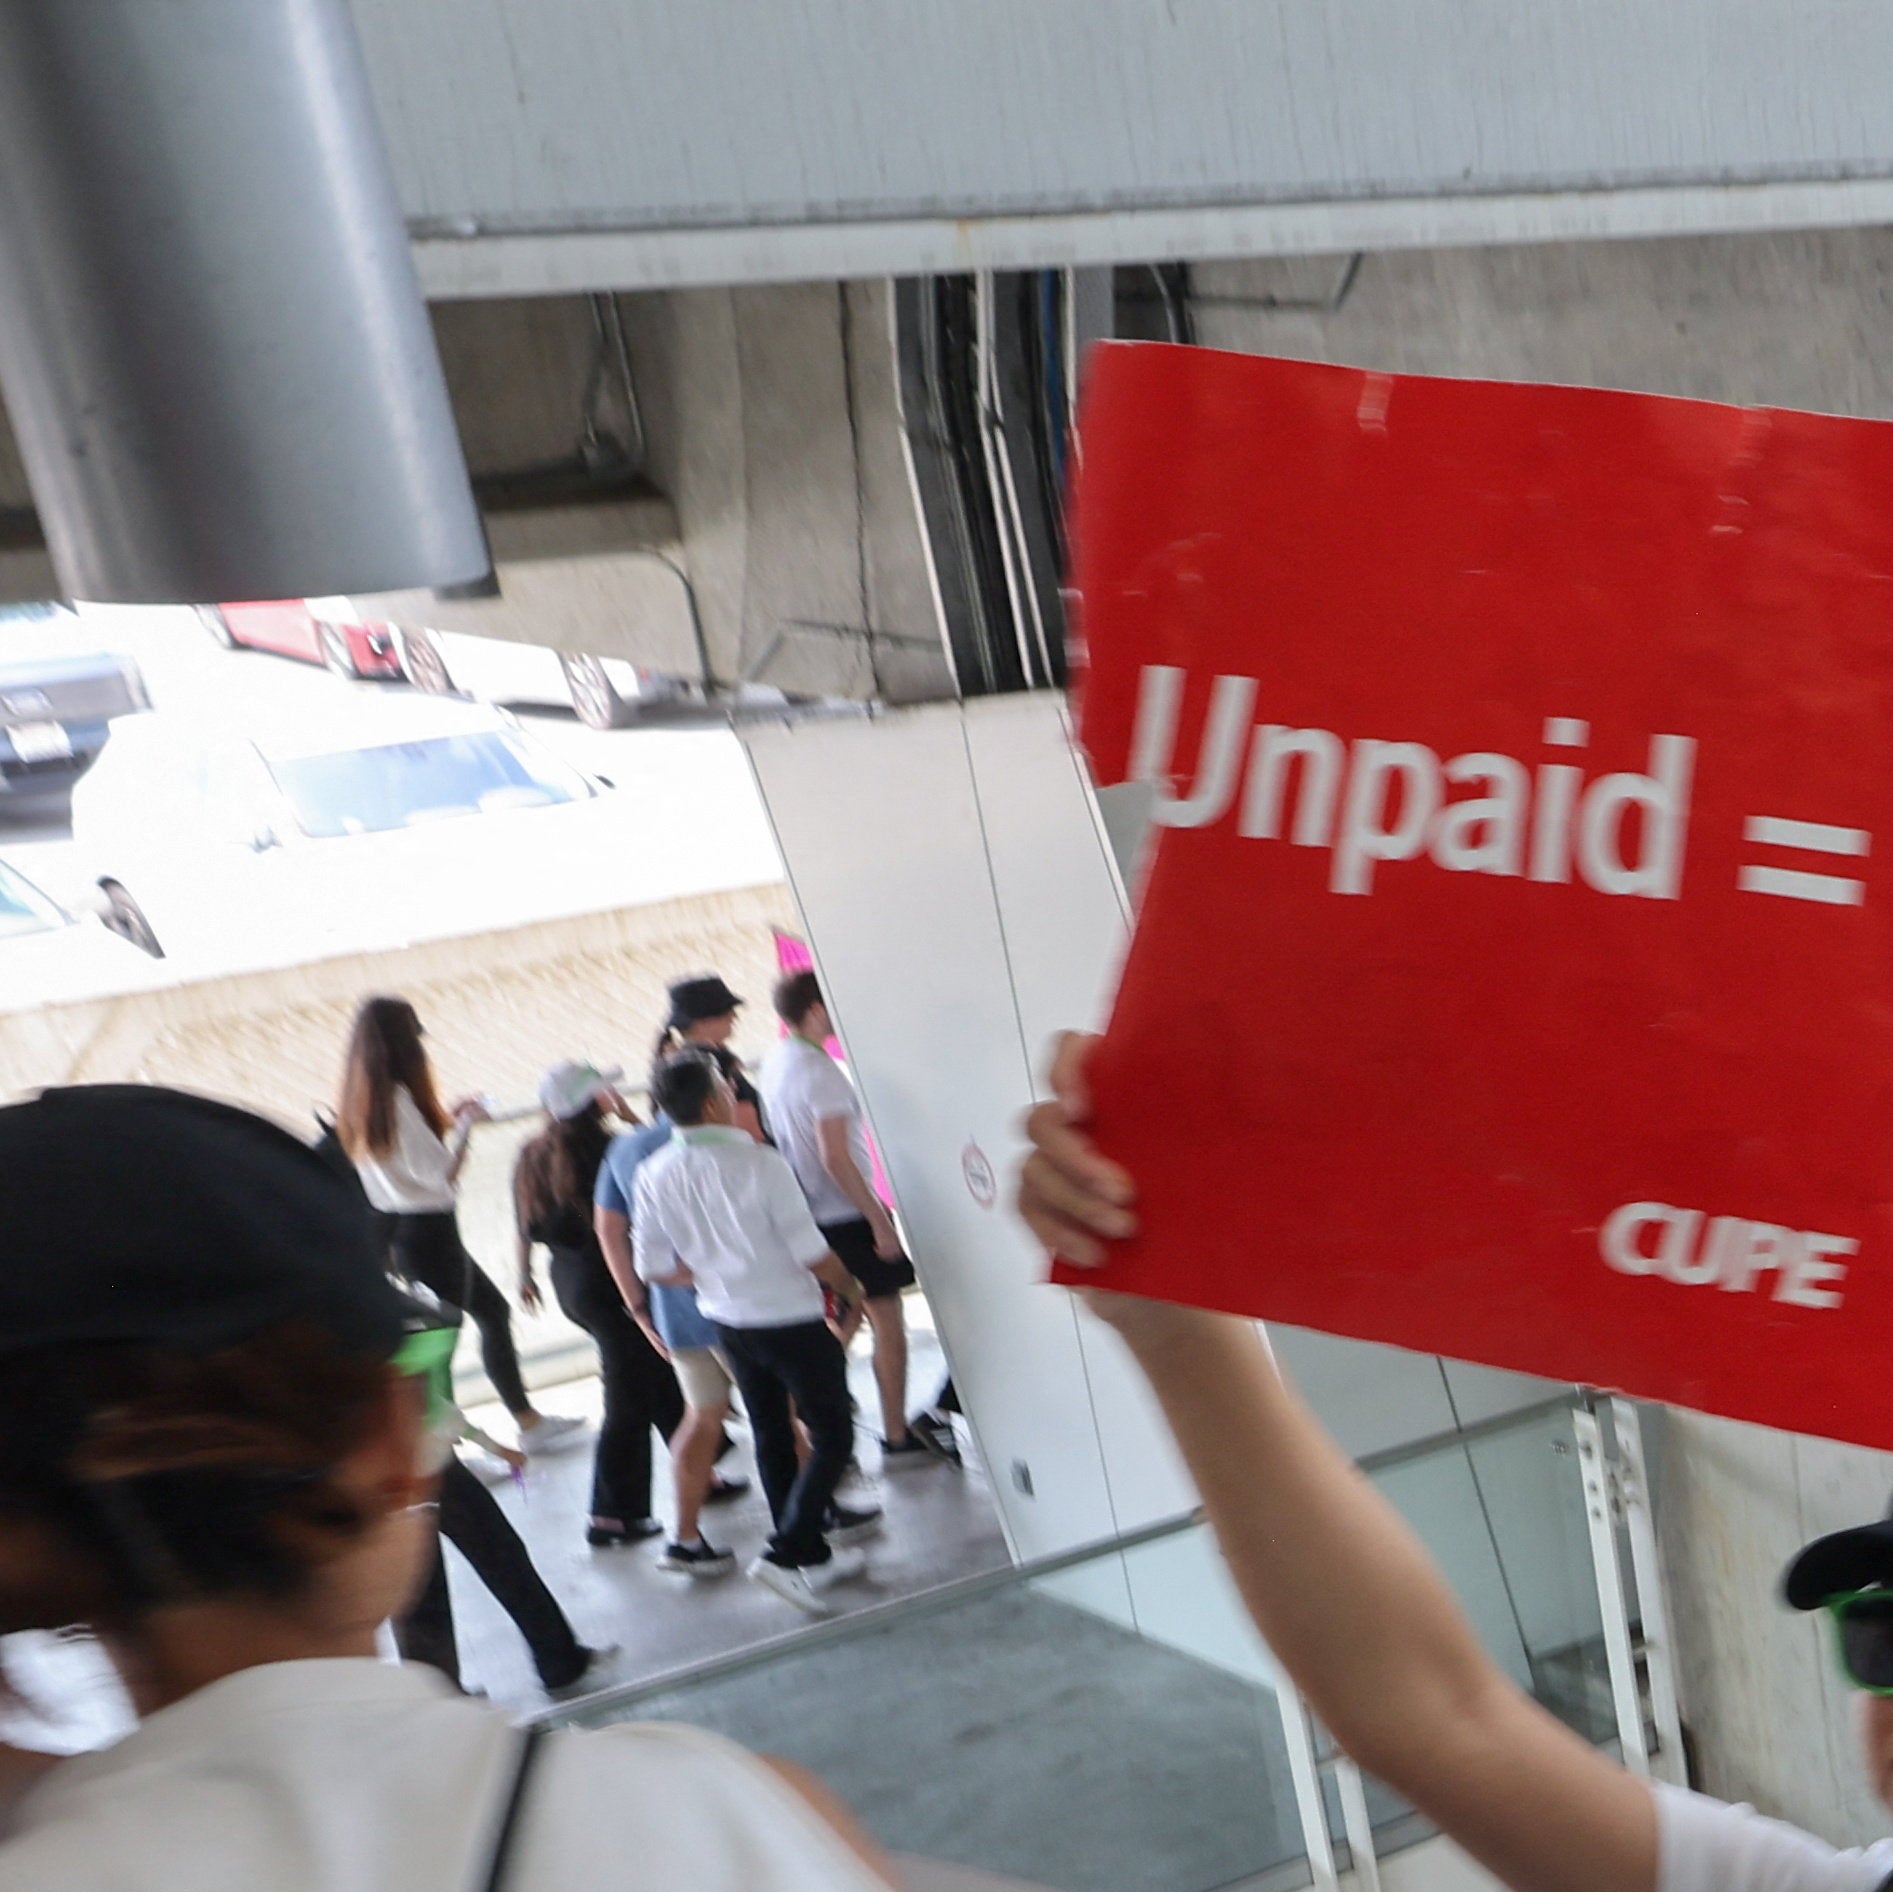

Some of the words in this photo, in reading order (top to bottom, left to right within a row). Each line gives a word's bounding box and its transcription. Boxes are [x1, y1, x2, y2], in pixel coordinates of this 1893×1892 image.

[1131, 665, 1697, 896] Unpaid
[1738, 813, 1872, 909] =
[1602, 1198, 1858, 1312] CUPE
